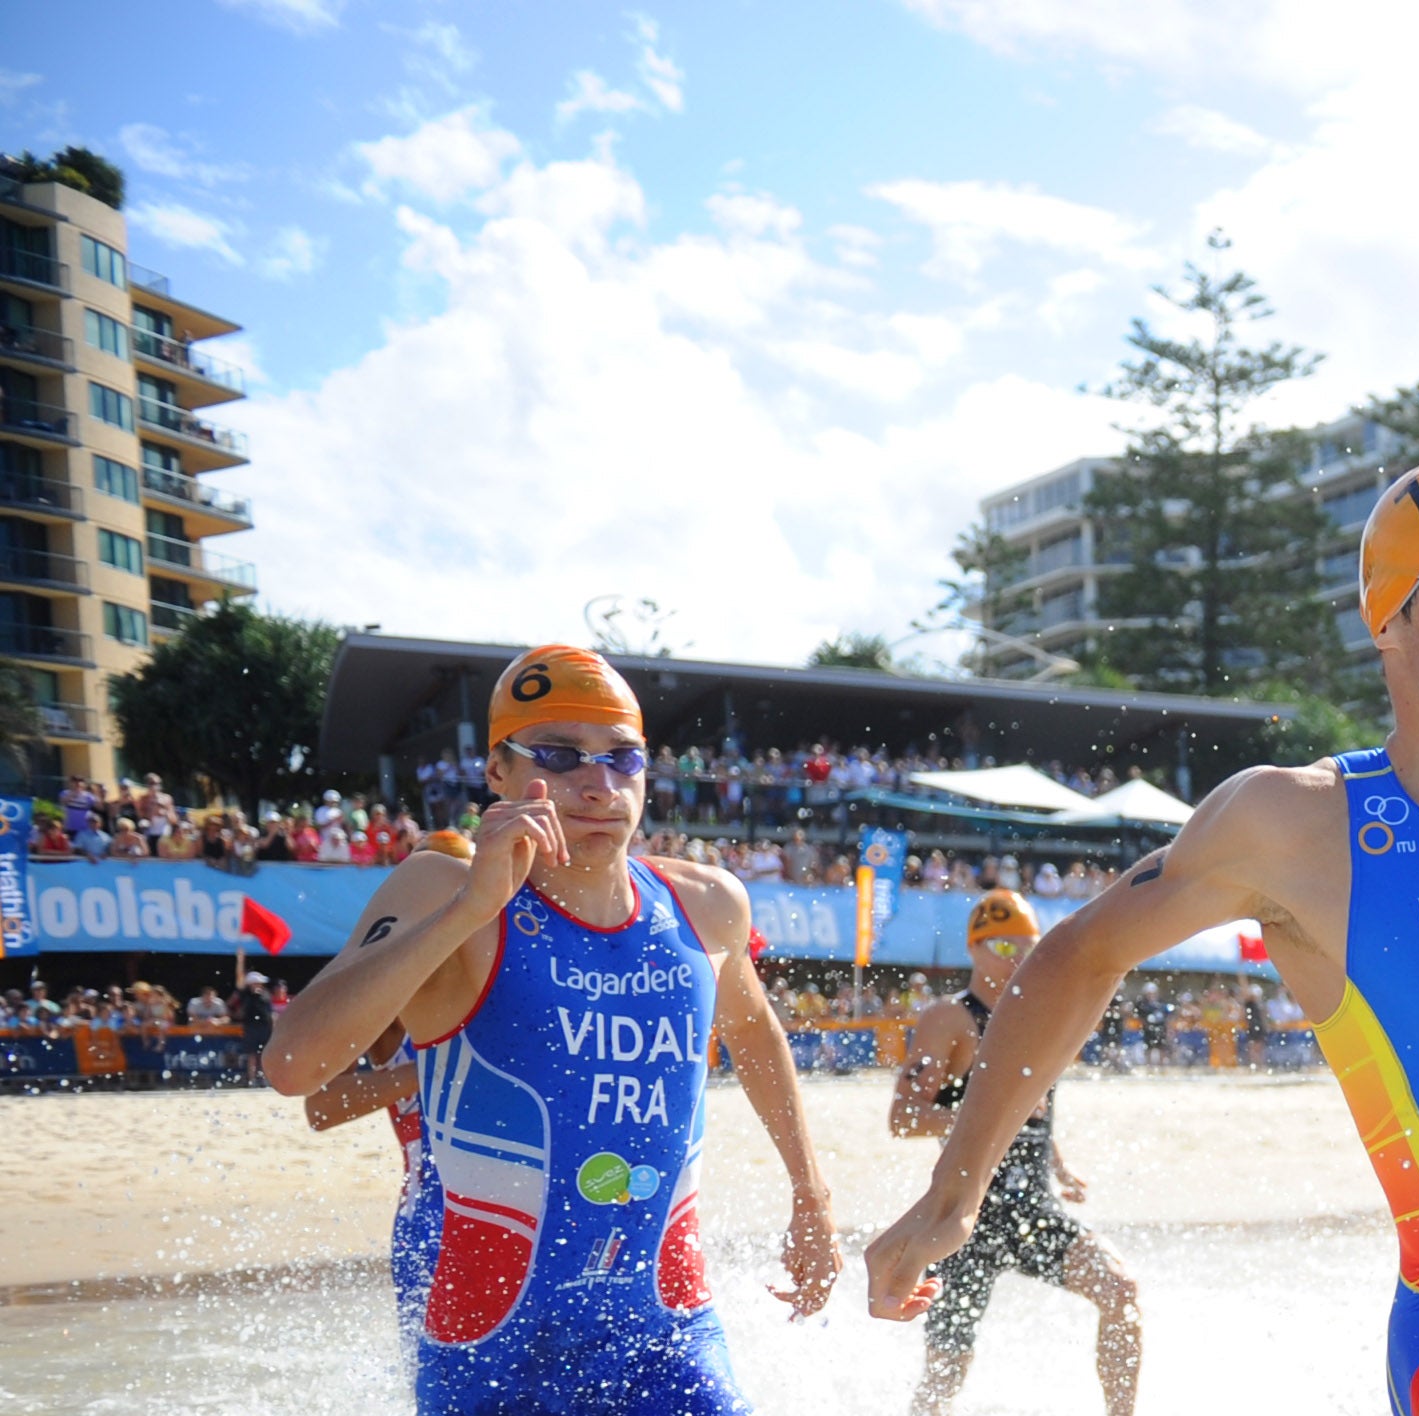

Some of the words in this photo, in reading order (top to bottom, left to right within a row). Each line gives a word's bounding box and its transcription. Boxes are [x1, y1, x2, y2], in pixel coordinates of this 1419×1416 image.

[511, 663, 552, 702] 6
[1396, 840, 1416, 853] ITU
[360, 916, 398, 947] 6
[755, 893, 840, 947] aba
[557, 1006, 702, 1063] VIDAL
[587, 1074, 669, 1127] FRA
